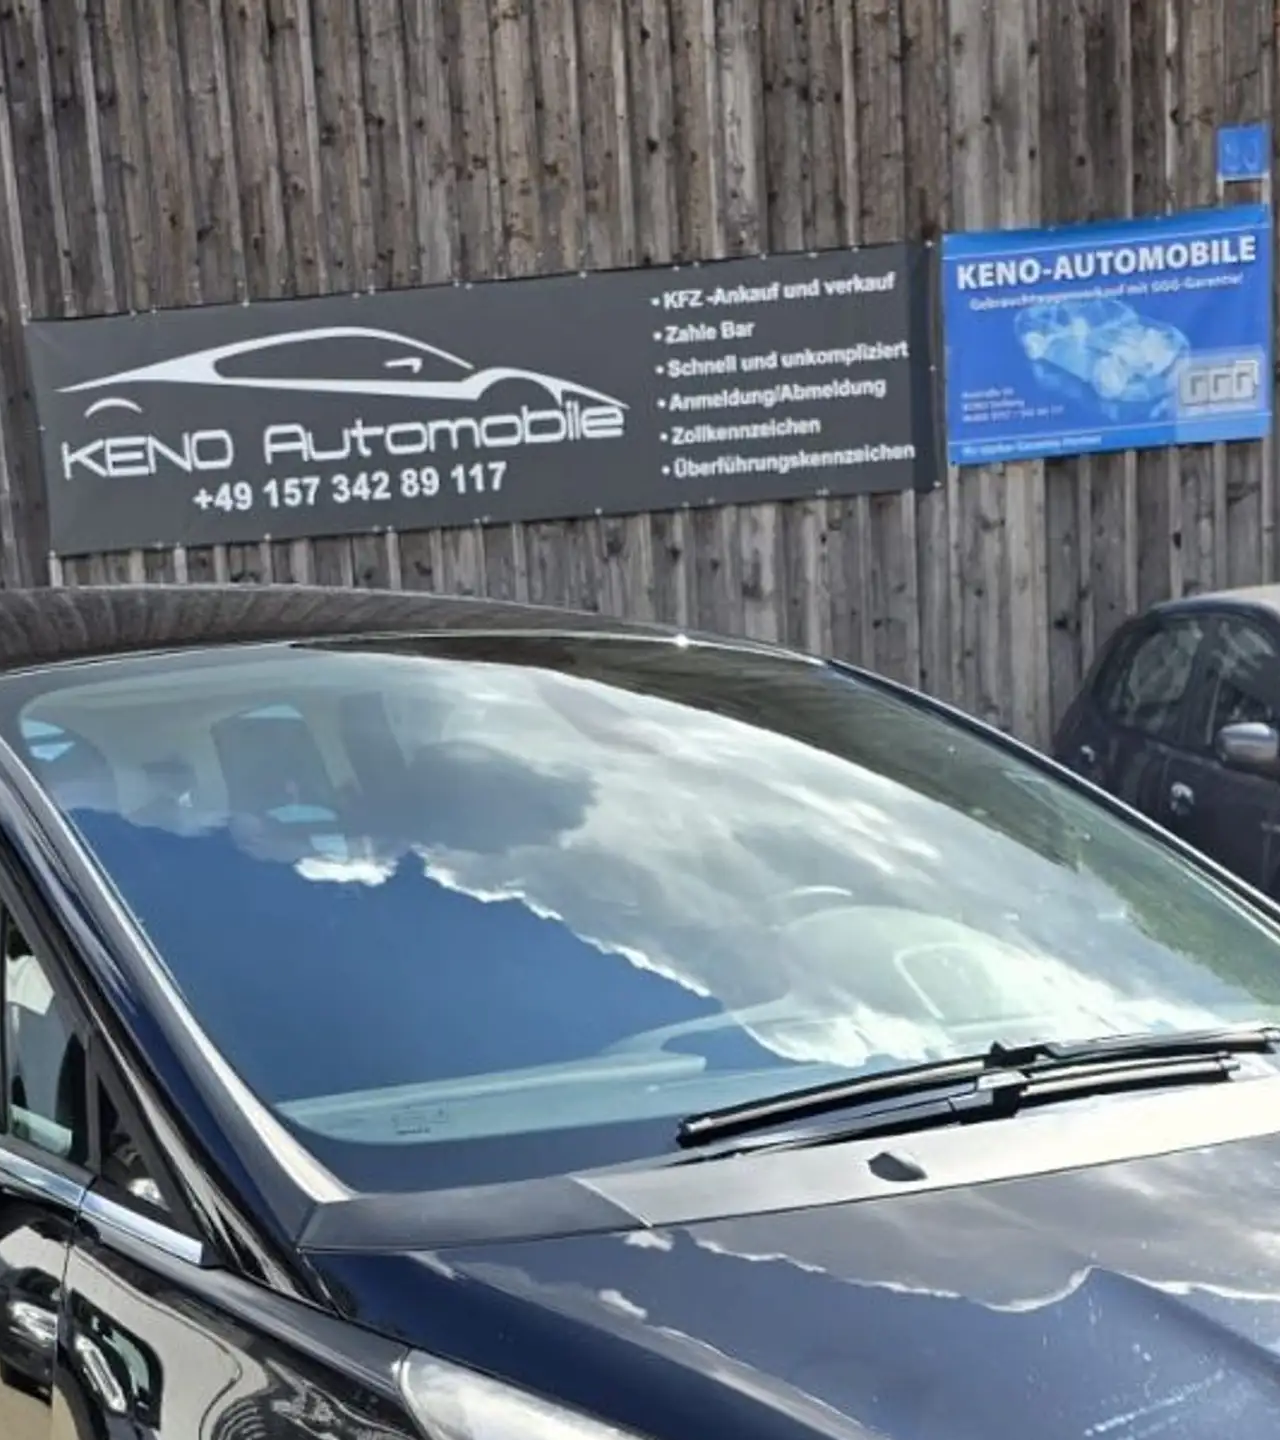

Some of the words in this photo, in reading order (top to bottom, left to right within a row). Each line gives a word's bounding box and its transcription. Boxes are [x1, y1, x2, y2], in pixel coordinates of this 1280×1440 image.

[956, 236, 1257, 290] KENO-AUTOMOBILE
[783, 278, 819, 299] und
[823, 271, 896, 295] verkauf
[721, 319, 755, 340] Bar
[667, 354, 737, 379] Schnell
[741, 351, 778, 372] und
[782, 340, 910, 366] unkompliziert
[61, 429, 234, 480] KENO
[264, 401, 625, 466] Automobile
[671, 417, 822, 445] Zollkennzeichen
[193, 479, 253, 513] +49
[263, 477, 320, 508] 157
[332, 471, 391, 503] 342
[400, 467, 441, 498] 89
[450, 462, 508, 494] 117
